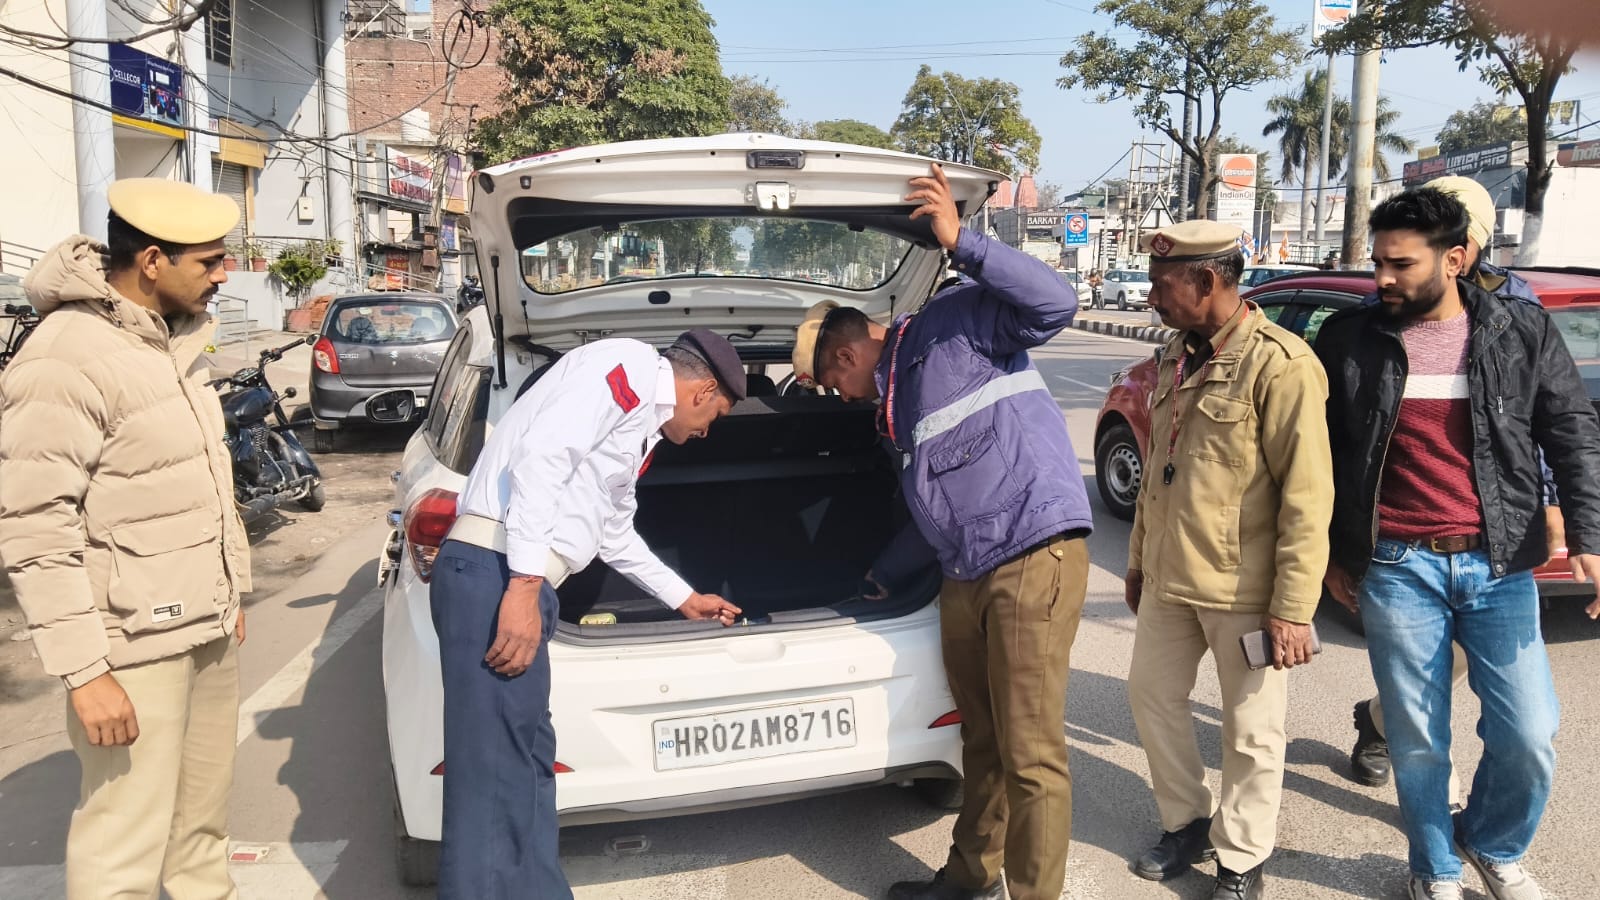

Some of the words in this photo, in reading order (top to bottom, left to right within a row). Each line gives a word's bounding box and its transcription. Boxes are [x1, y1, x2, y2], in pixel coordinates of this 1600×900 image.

[113, 69, 141, 85] CELLECOR
[1220, 190, 1254, 198] IndianOil
[1027, 216, 1058, 225] BARKAT
[658, 740, 675, 750] IND
[674, 708, 851, 758] HR02AM8716
